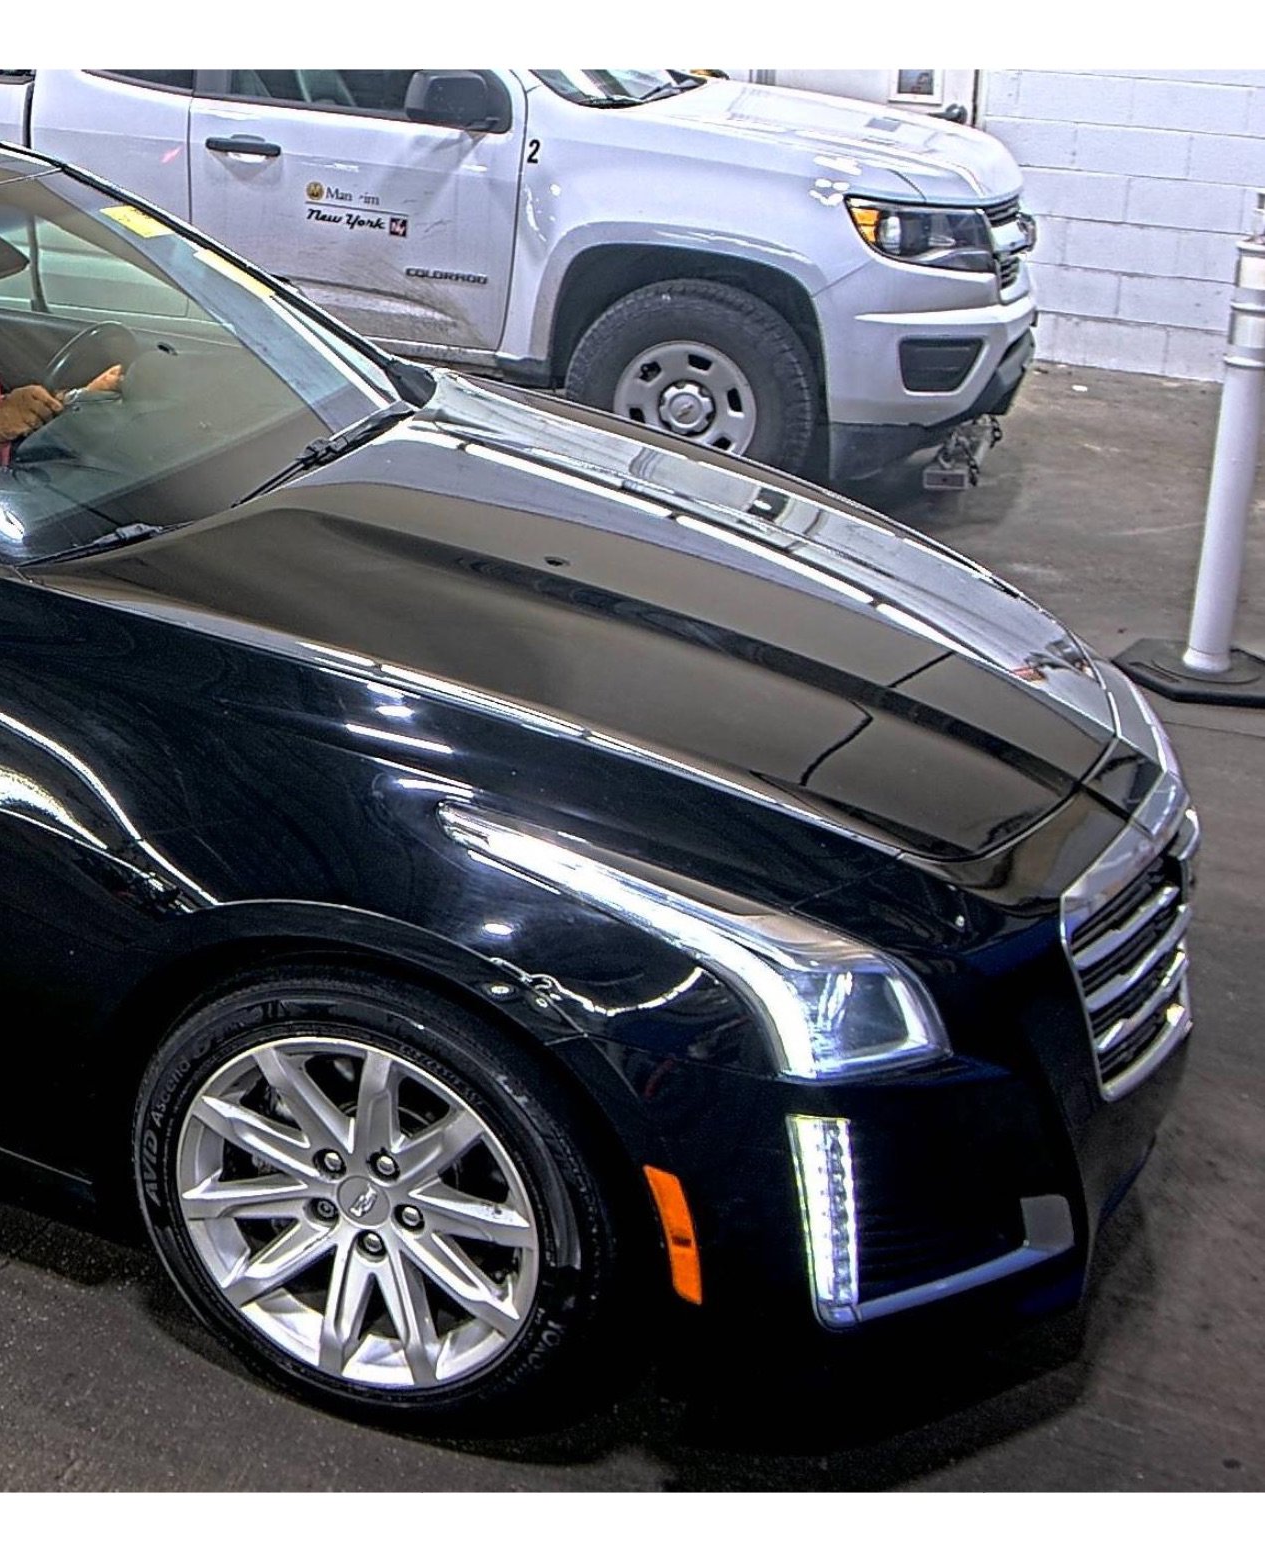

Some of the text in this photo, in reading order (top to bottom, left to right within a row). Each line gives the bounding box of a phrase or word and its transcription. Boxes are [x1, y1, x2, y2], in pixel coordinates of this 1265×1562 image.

[526, 139, 541, 164] 2
[326, 187, 380, 205] Manim
[306, 208, 386, 230] New York
[405, 267, 488, 284] COLORADO
[141, 1129, 161, 1207] AVID
